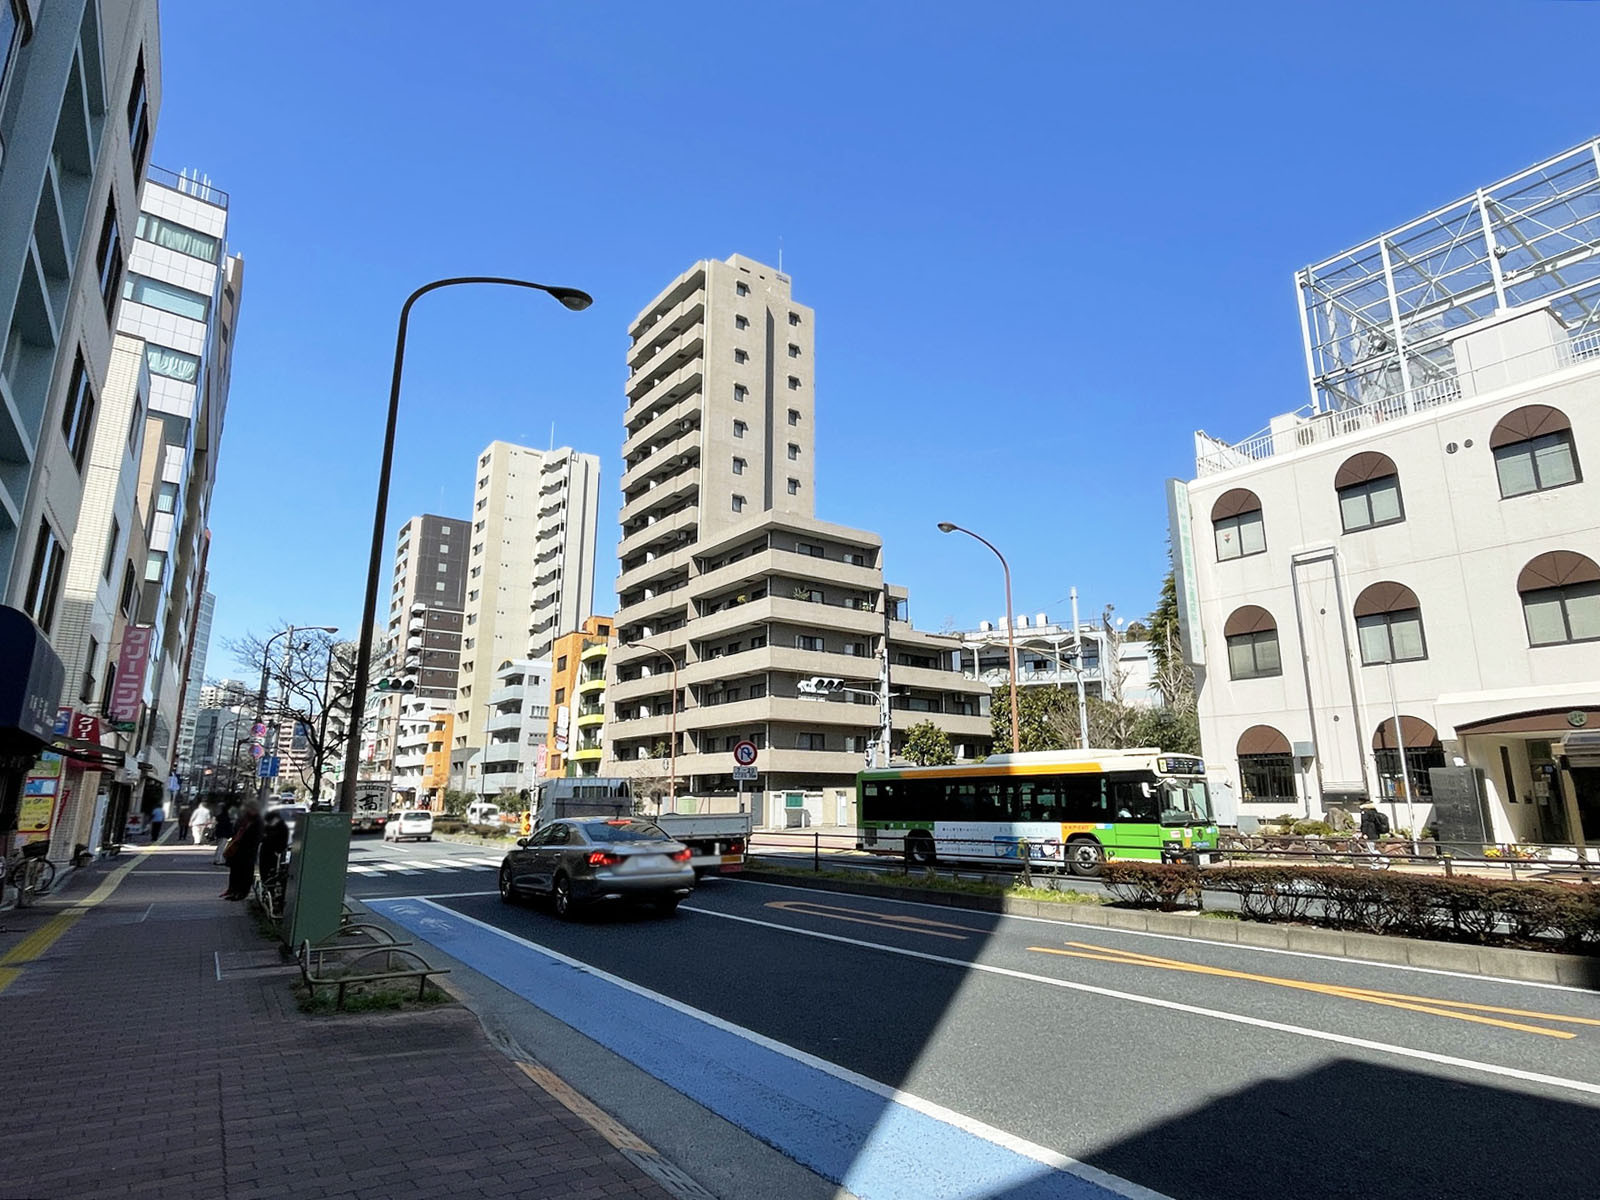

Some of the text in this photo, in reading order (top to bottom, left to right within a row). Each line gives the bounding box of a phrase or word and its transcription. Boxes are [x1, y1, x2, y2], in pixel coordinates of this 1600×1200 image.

[115, 630, 146, 720] クリーニング
[358, 793, 379, 811] 高
